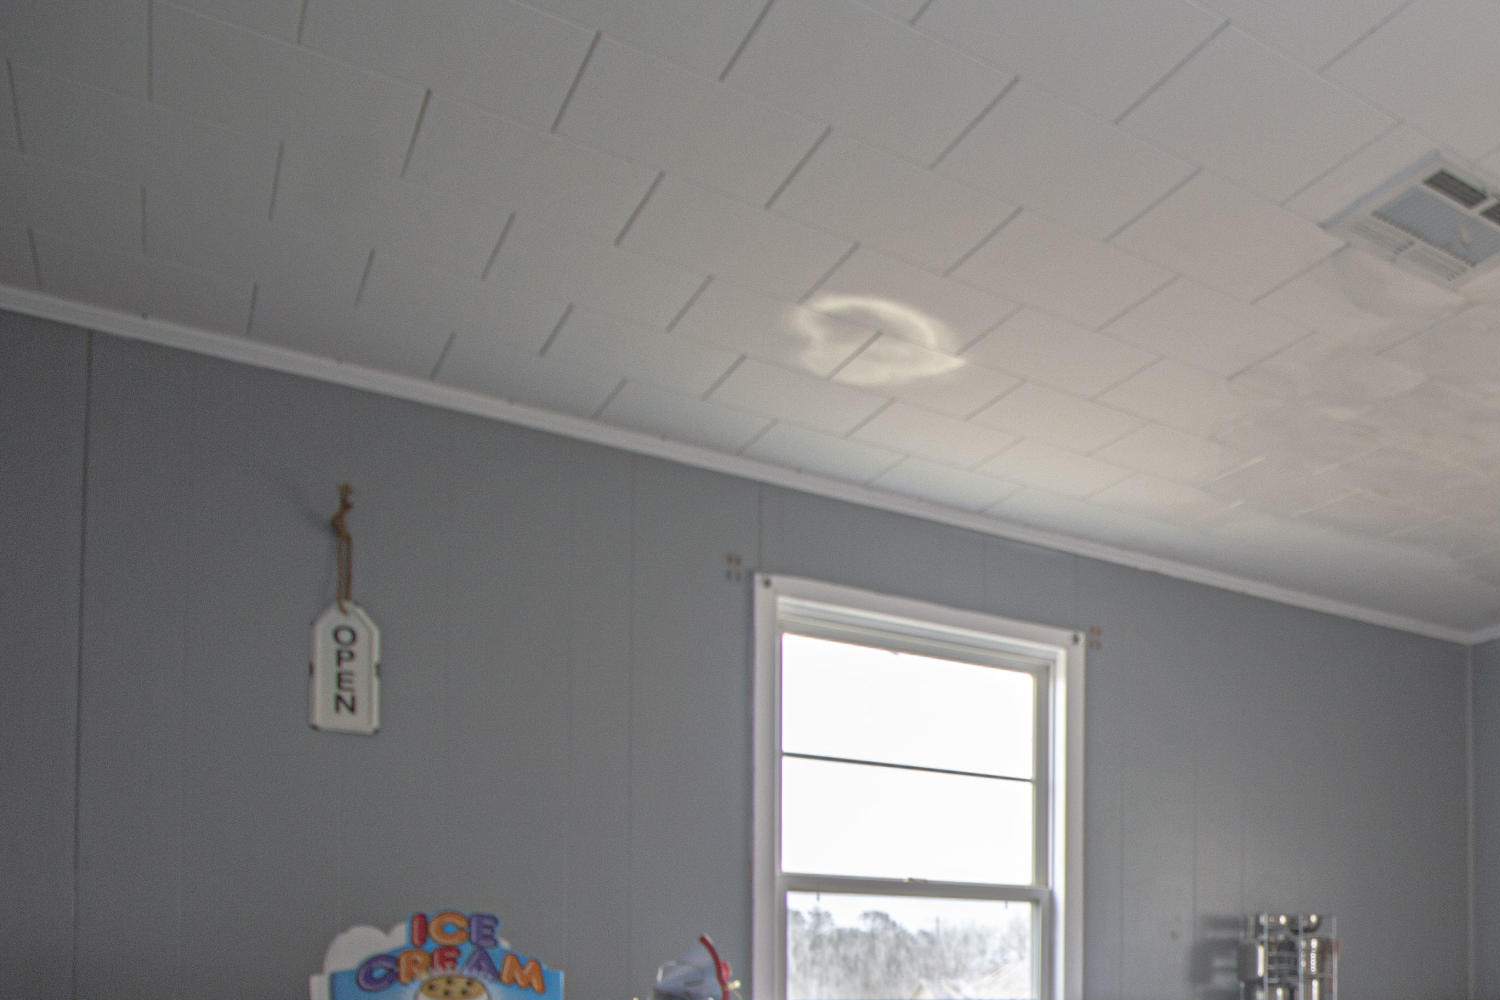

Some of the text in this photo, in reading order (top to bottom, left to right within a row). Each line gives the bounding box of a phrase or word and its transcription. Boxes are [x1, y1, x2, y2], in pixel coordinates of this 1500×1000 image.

[333, 624, 357, 715] OPEN
[410, 911, 498, 948] ICE
[356, 946, 545, 994] CREAM
